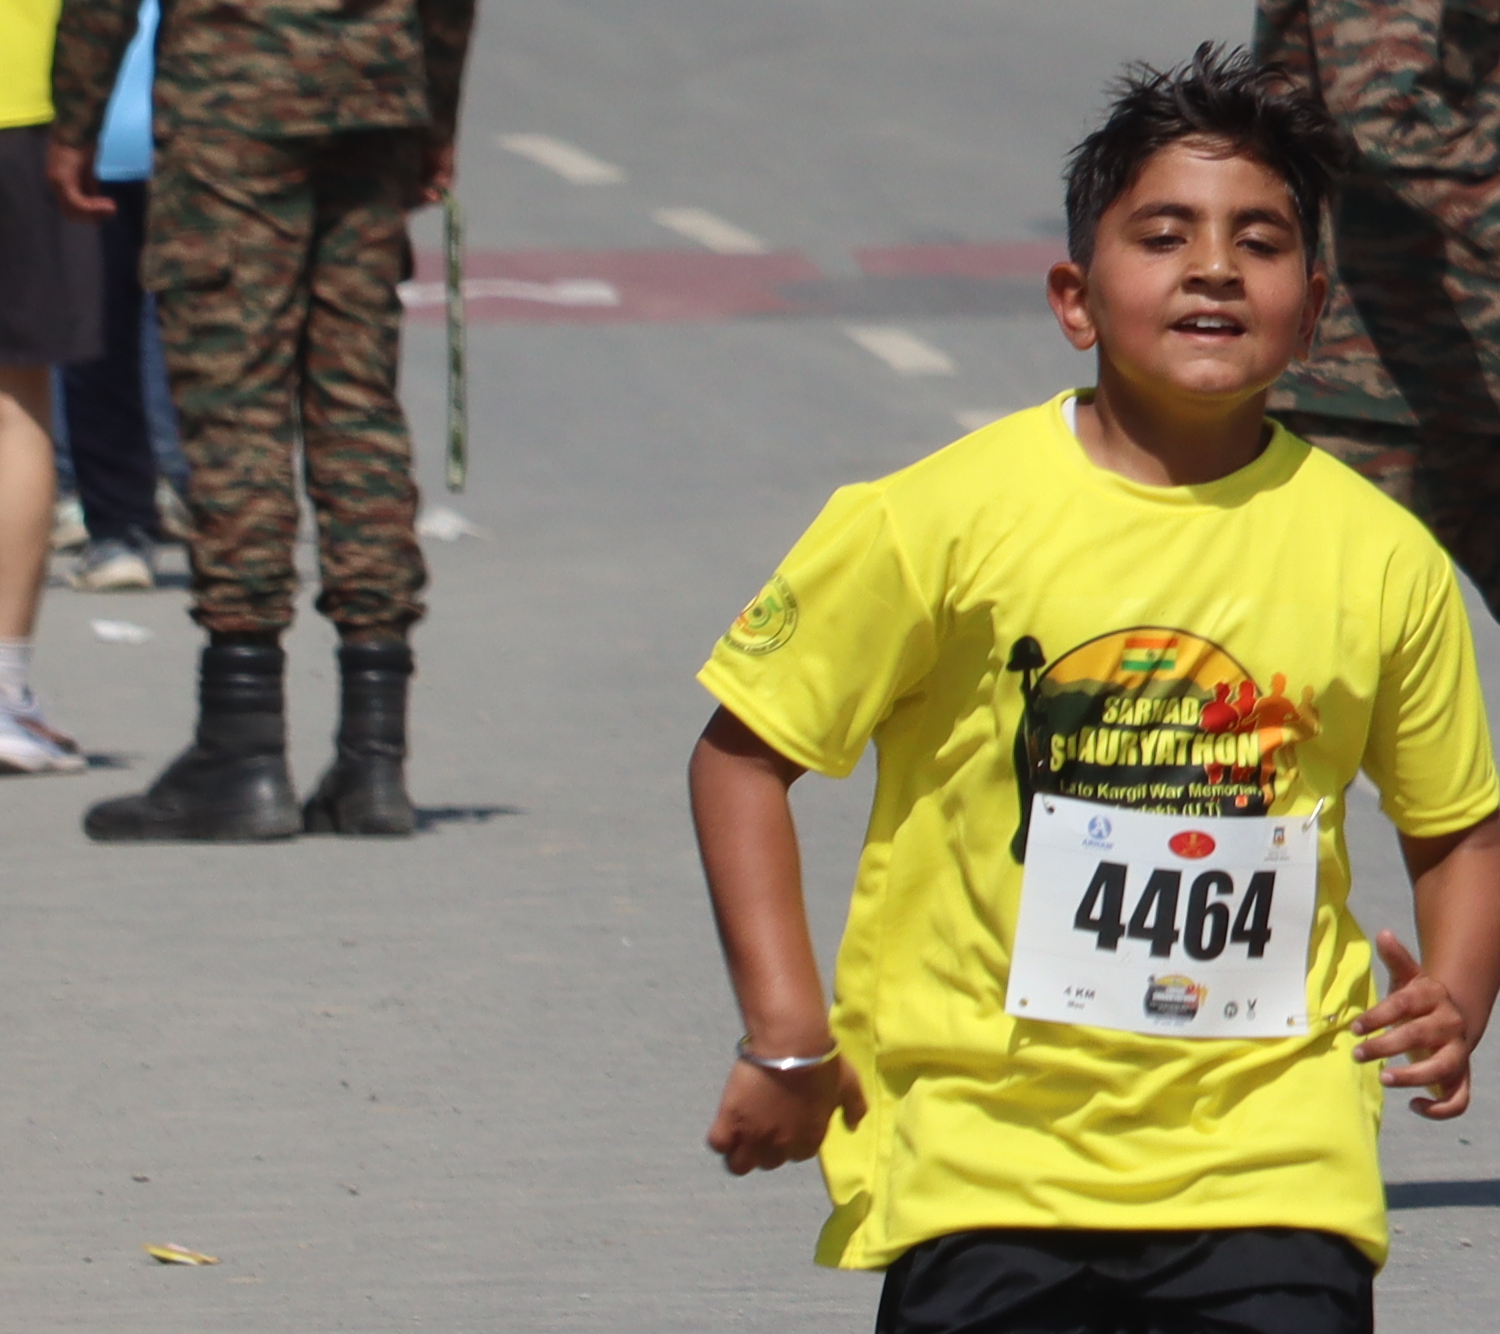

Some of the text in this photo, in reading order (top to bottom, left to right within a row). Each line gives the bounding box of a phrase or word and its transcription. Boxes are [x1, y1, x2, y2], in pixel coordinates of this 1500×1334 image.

[1096, 782, 1147, 802] Kargil
[1149, 782, 1184, 799] War
[1072, 860, 1277, 961] 4464
[1063, 984, 1096, 1000] 4 KM
